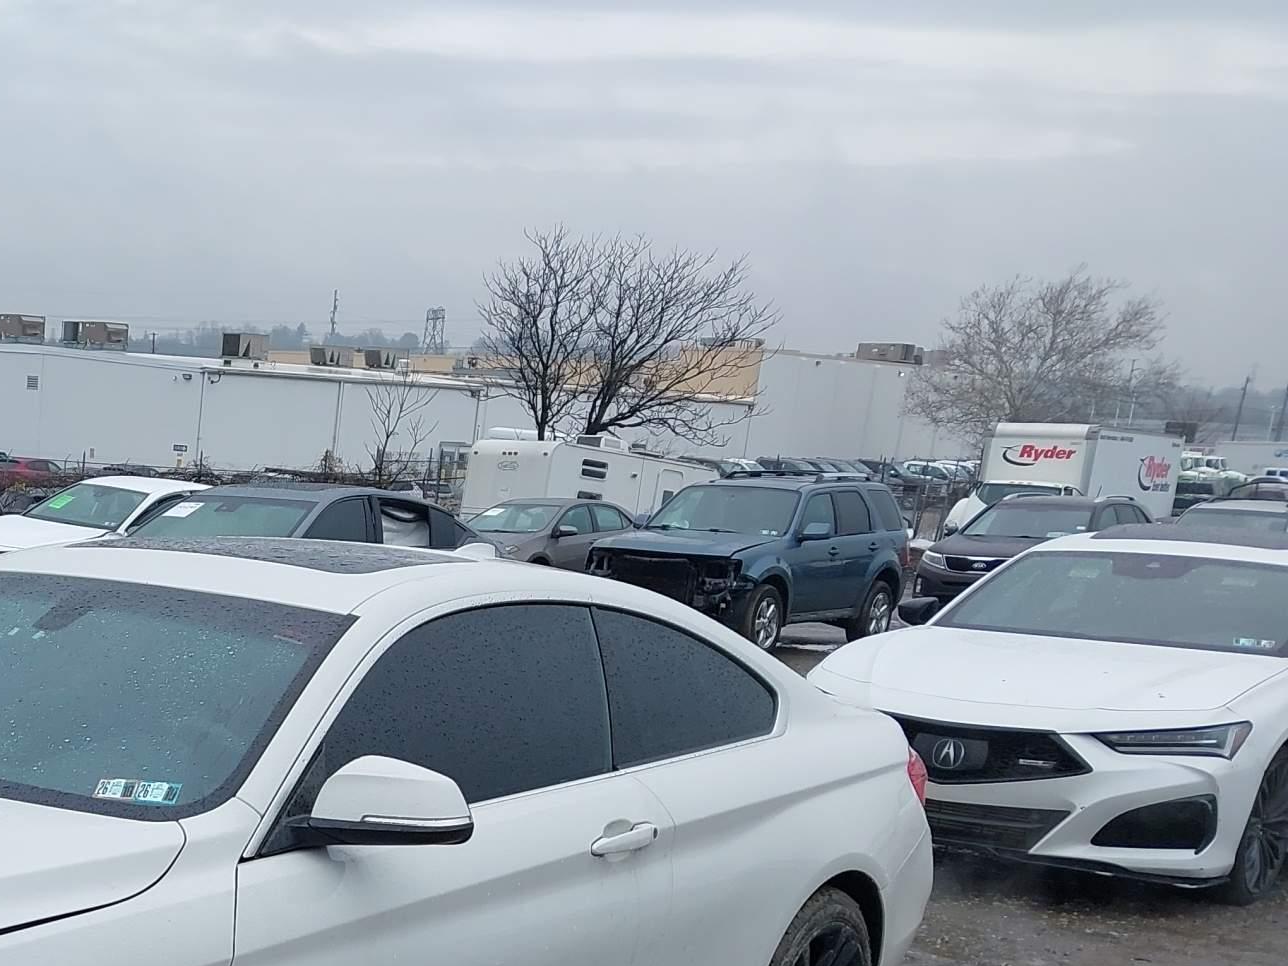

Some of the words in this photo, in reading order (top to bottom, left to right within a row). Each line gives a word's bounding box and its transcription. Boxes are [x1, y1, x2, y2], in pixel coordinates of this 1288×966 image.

[1019, 445, 1076, 461] Ryder
[97, 782, 109, 795] 26
[138, 783, 151, 798] 26
